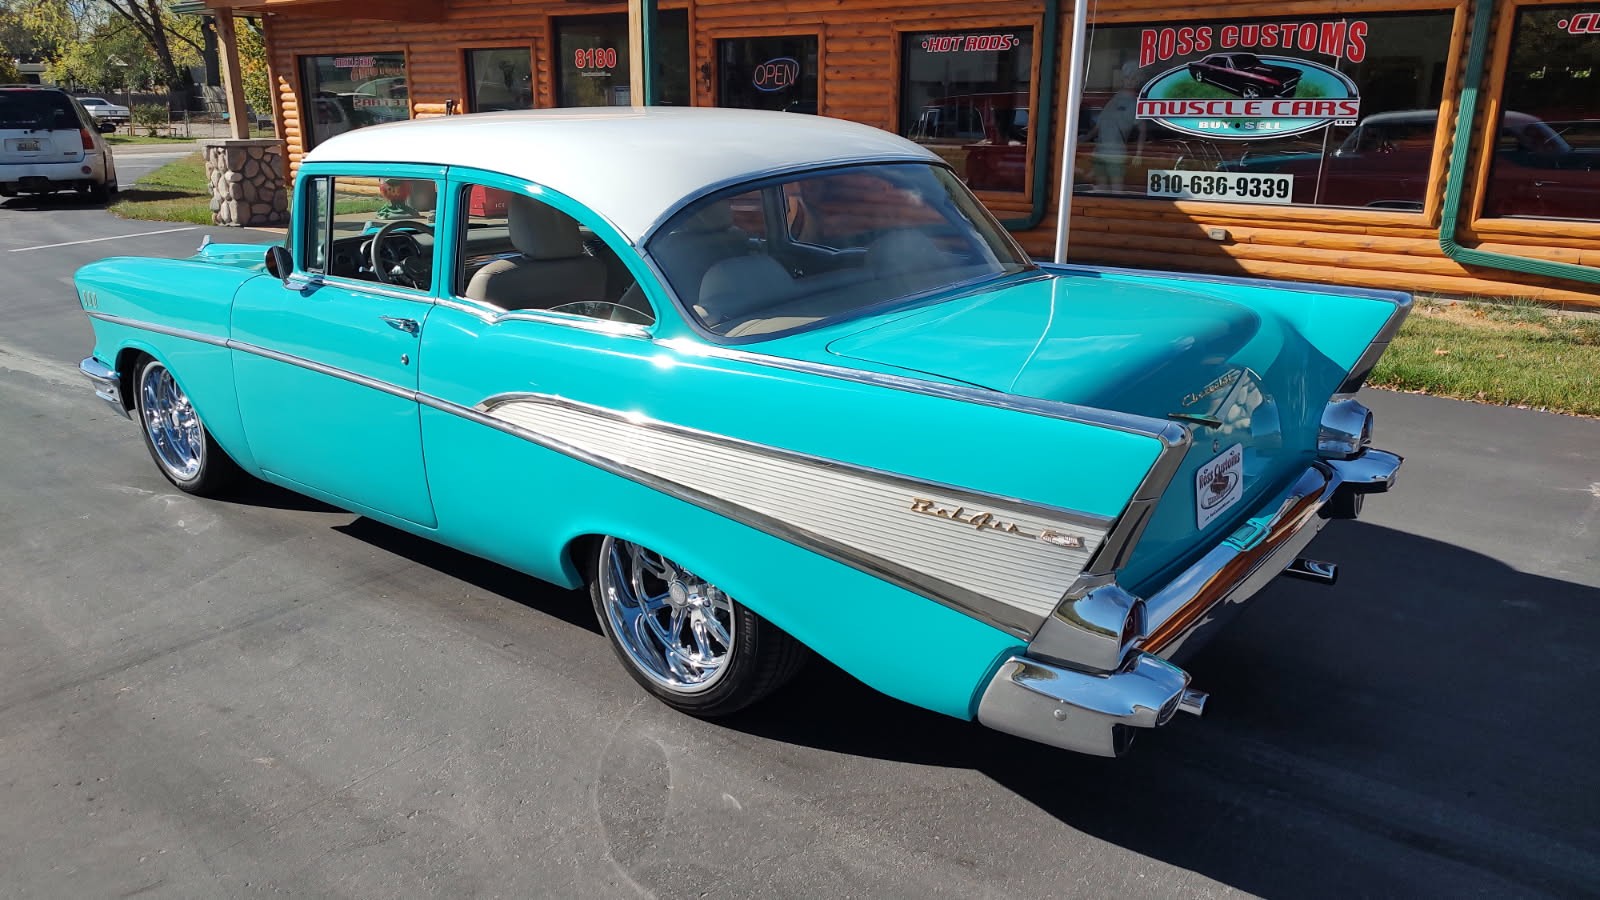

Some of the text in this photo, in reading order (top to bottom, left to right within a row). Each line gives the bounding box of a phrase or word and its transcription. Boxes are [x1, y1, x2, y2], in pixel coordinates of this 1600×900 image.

[927, 34, 1014, 53] HOT RODS
[1139, 21, 1368, 68] ROSS CUSTOMS
[575, 48, 616, 68] 8180
[755, 64, 796, 85] OPEN
[1137, 101, 1358, 117] MUSCLE CARS
[1198, 120, 1281, 130] BUY SELL
[1150, 173, 1290, 199] 810-636-9339
